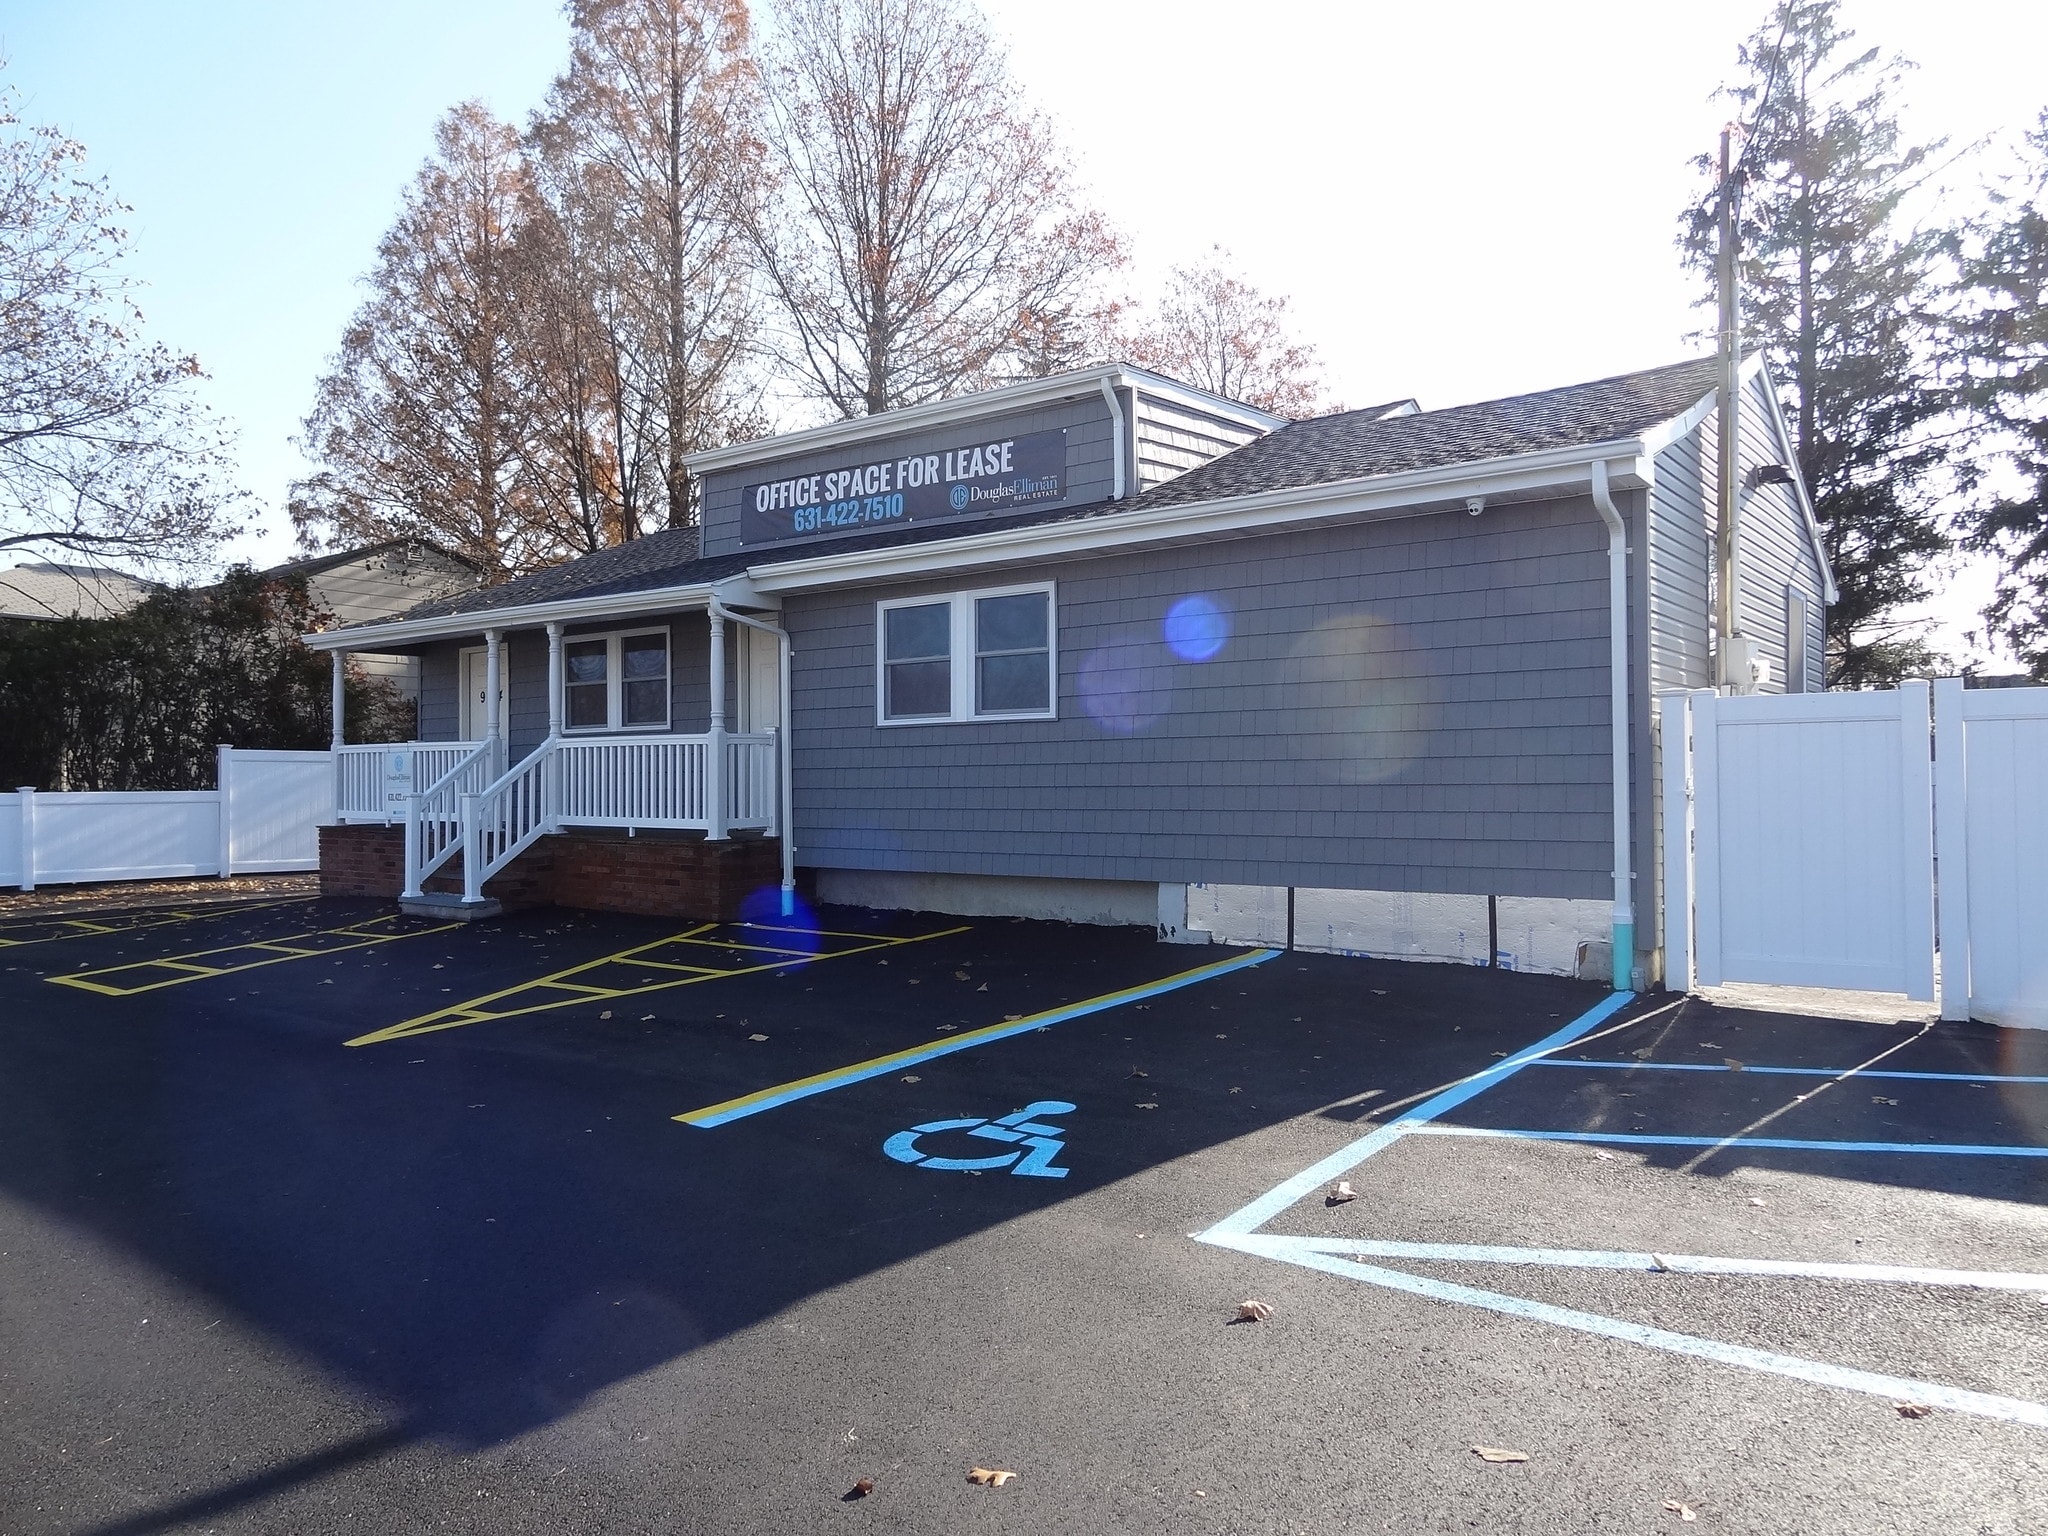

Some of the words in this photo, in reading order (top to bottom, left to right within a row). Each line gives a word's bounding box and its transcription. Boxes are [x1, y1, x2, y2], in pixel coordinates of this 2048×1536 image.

[756, 475, 821, 513] OFFICE
[824, 462, 892, 501] SPACE
[897, 455, 940, 490] FOR
[945, 441, 1014, 482] LEASE
[1013, 493, 1031, 501] REAL
[1032, 489, 1058, 499] ESTATE
[794, 493, 904, 532] 631-422-7510
